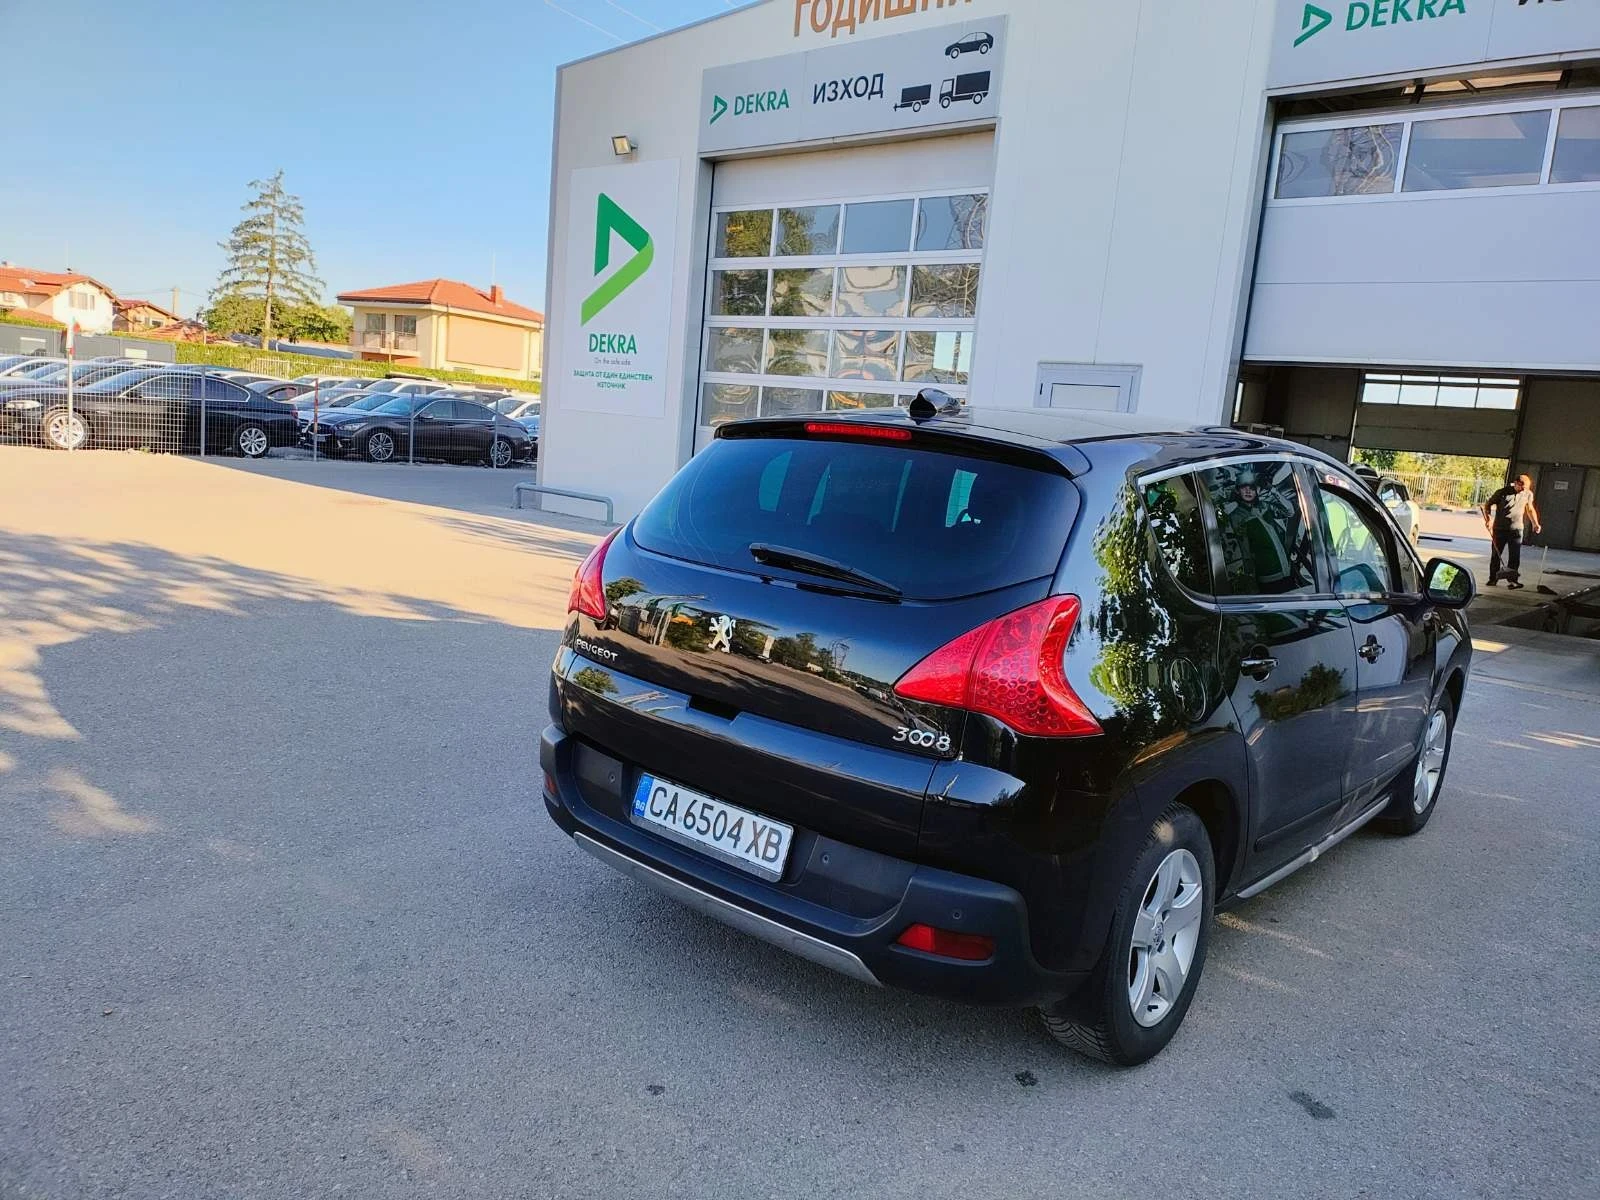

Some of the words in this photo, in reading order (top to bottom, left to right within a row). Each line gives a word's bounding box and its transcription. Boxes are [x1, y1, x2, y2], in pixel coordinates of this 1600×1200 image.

[794, 0, 972, 37] ГОДИ
[1346, 0, 1466, 31] DEKRA
[813, 73, 884, 104] ИЗХОД
[734, 89, 790, 115] DEKRA
[589, 333, 637, 354] DEKRA
[576, 638, 618, 661] PEUGEOT
[892, 726, 951, 751] 3008
[635, 800, 645, 811] BG
[683, 799, 744, 848] 6504
